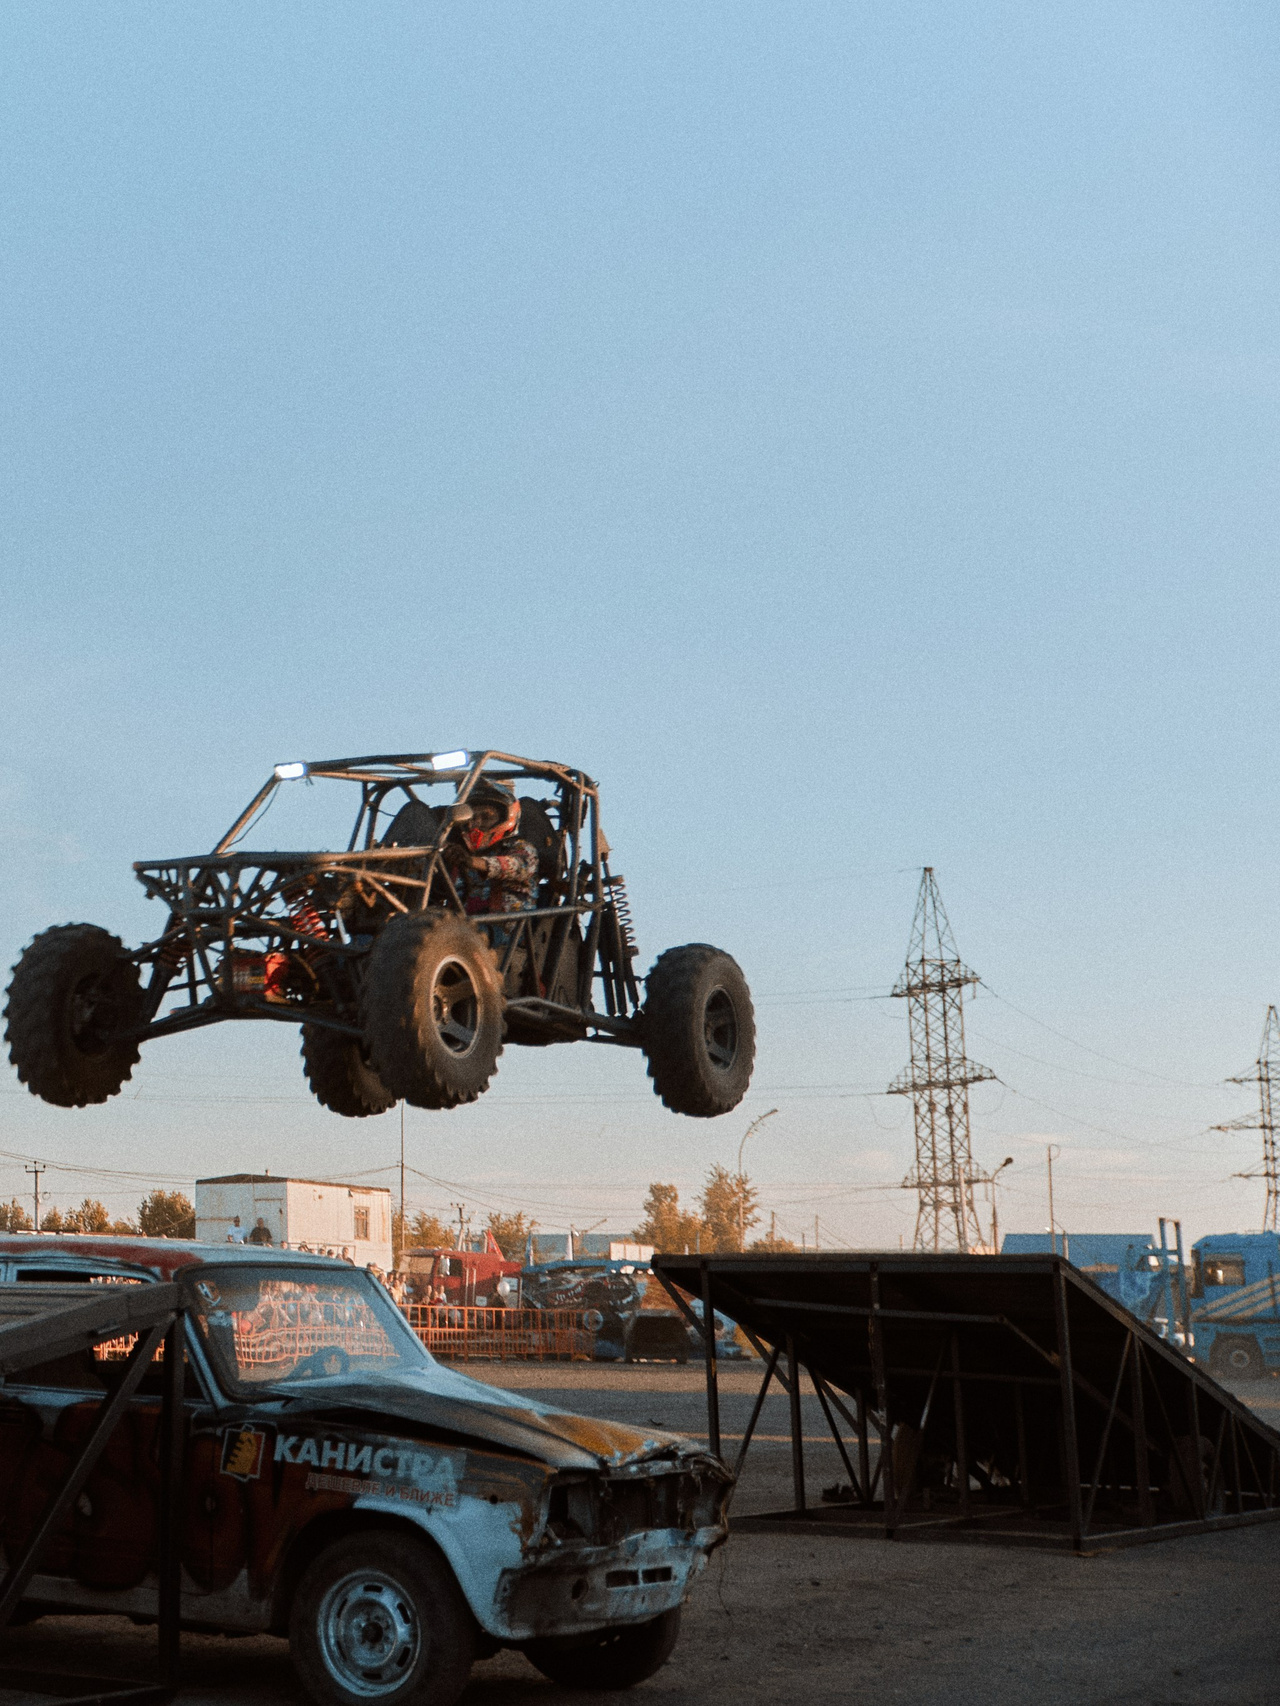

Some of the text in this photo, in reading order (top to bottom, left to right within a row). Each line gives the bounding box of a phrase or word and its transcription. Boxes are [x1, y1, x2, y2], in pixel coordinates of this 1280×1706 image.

[274, 1434, 455, 1479] КАНИСТРА
[305, 1472, 456, 1508] ДЕШЕВЛЕ И БЛИЖЕ
